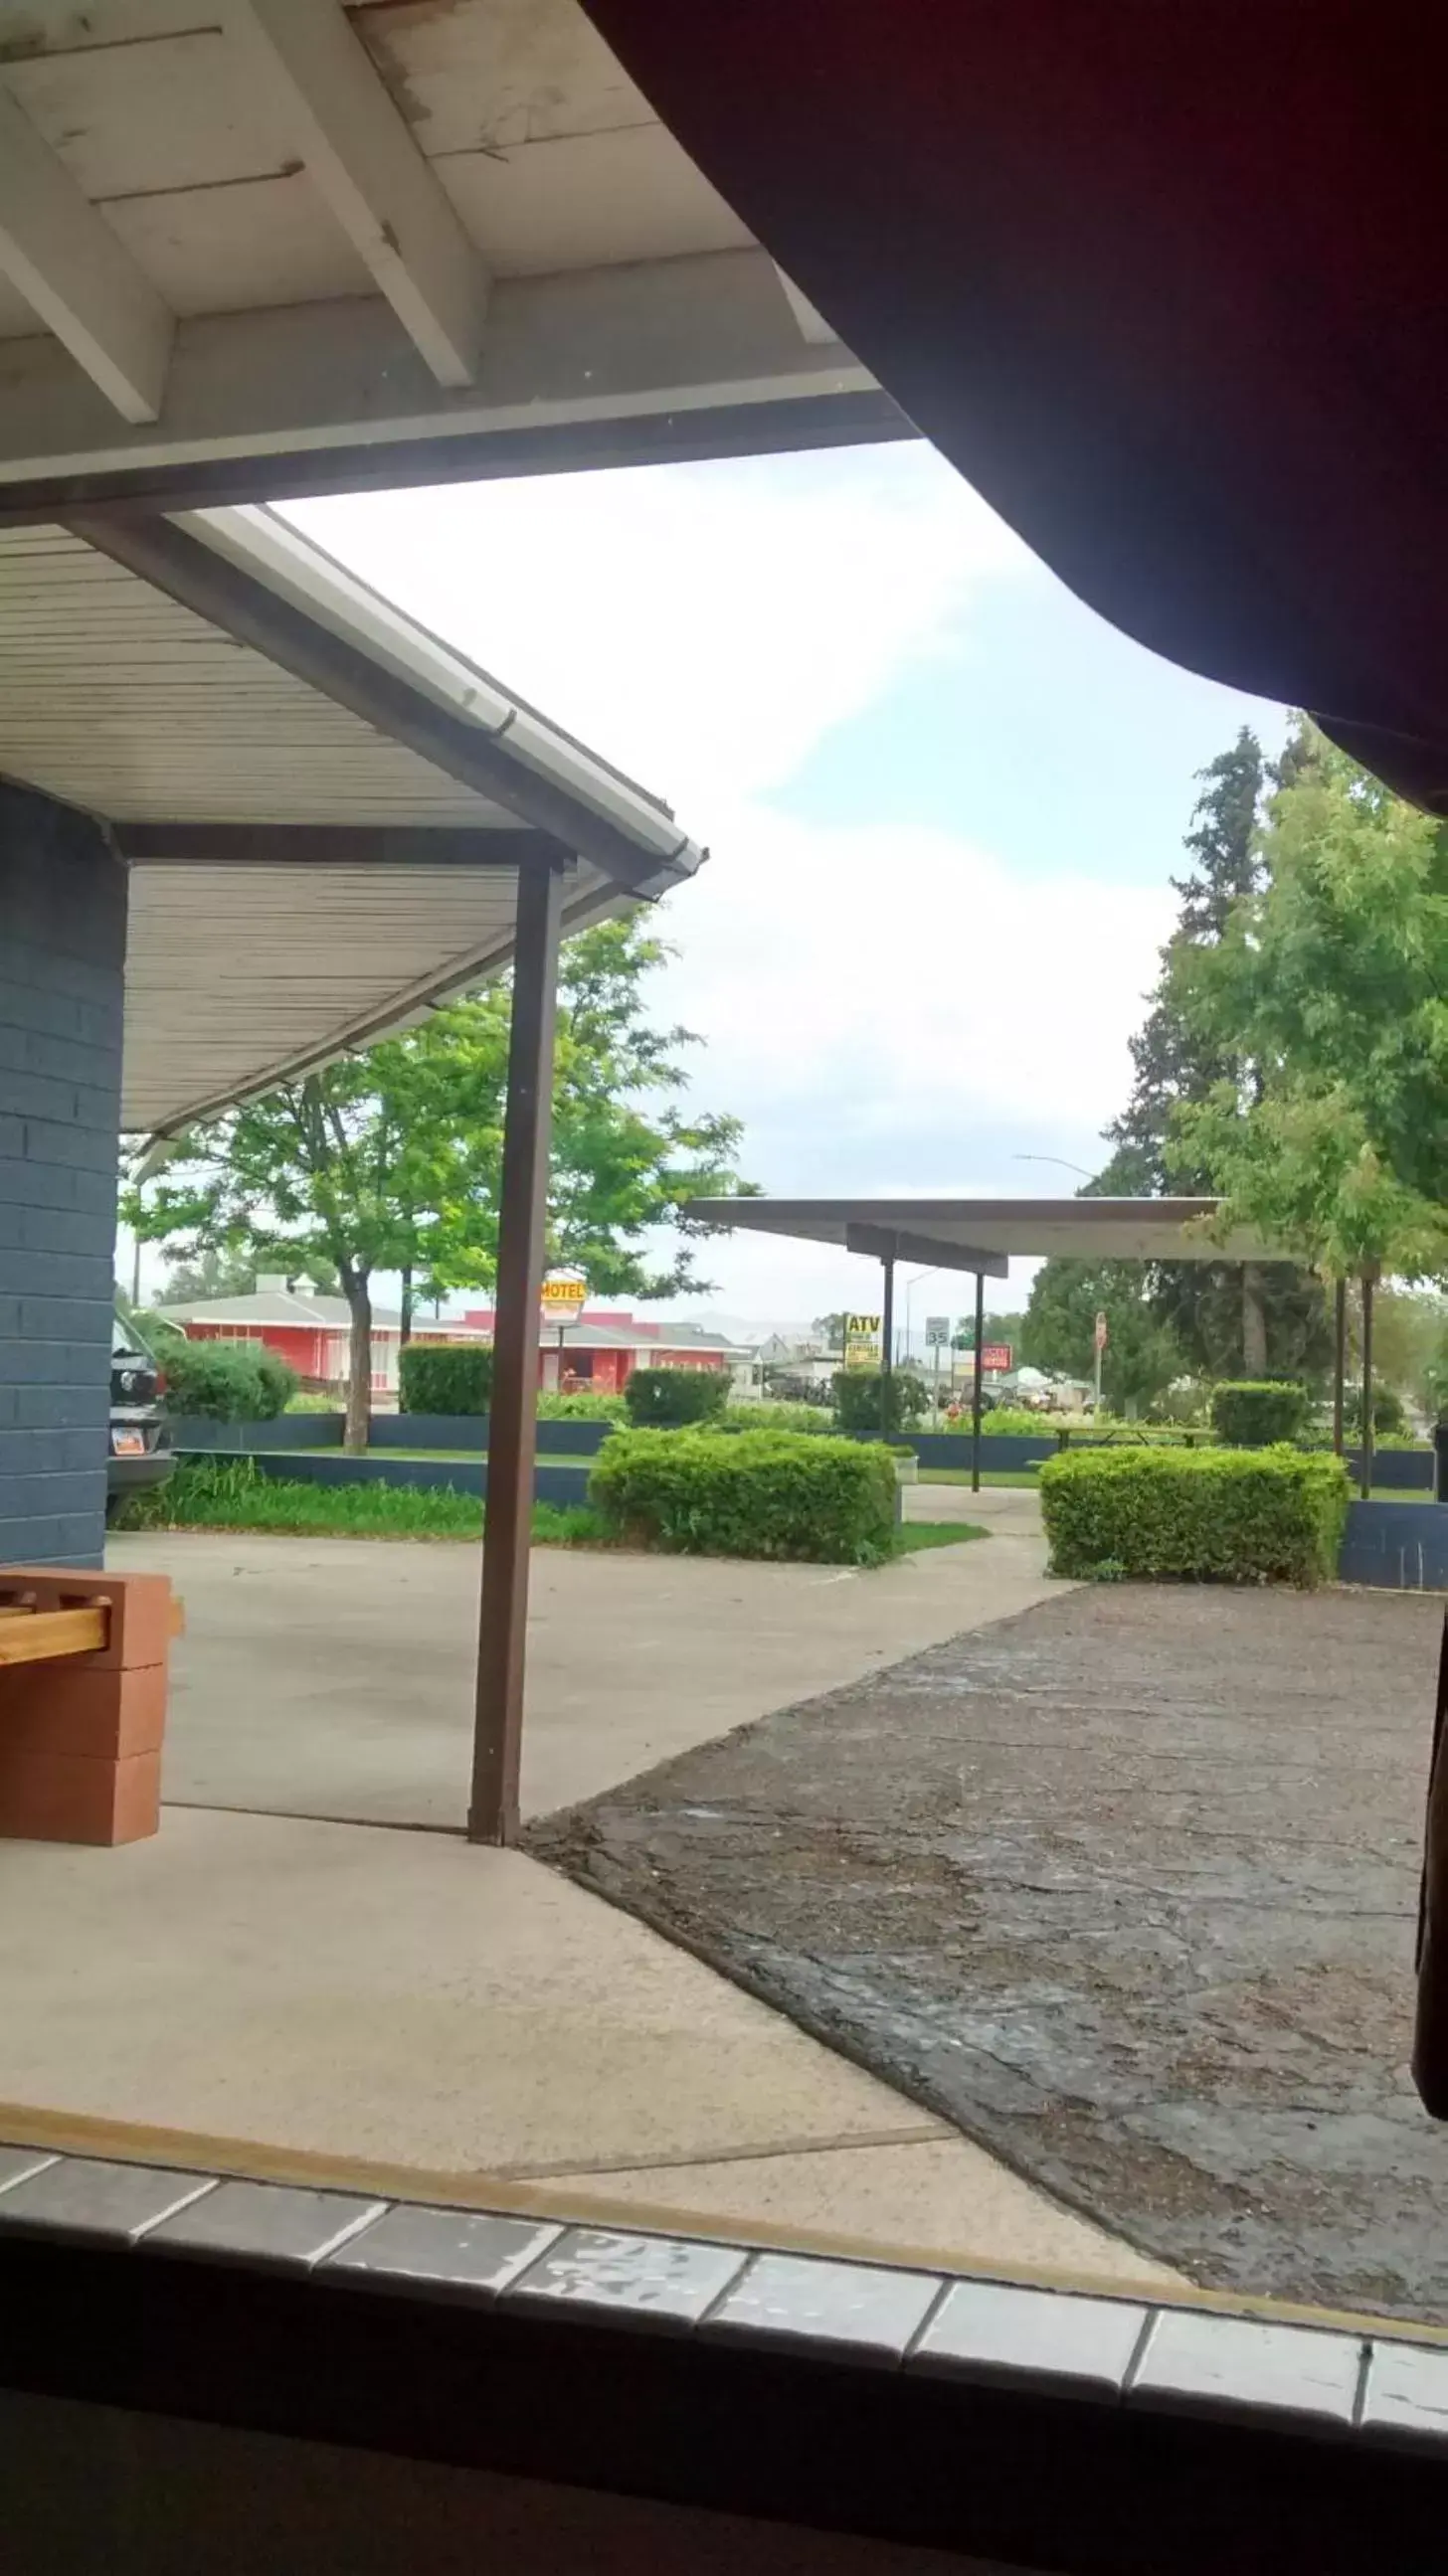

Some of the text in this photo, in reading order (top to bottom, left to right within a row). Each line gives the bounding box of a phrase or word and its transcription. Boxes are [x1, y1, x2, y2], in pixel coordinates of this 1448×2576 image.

[542, 1284, 583, 1297] MOTEL
[849, 1315, 880, 1332] ATV
[928, 1332, 948, 1344] 35
